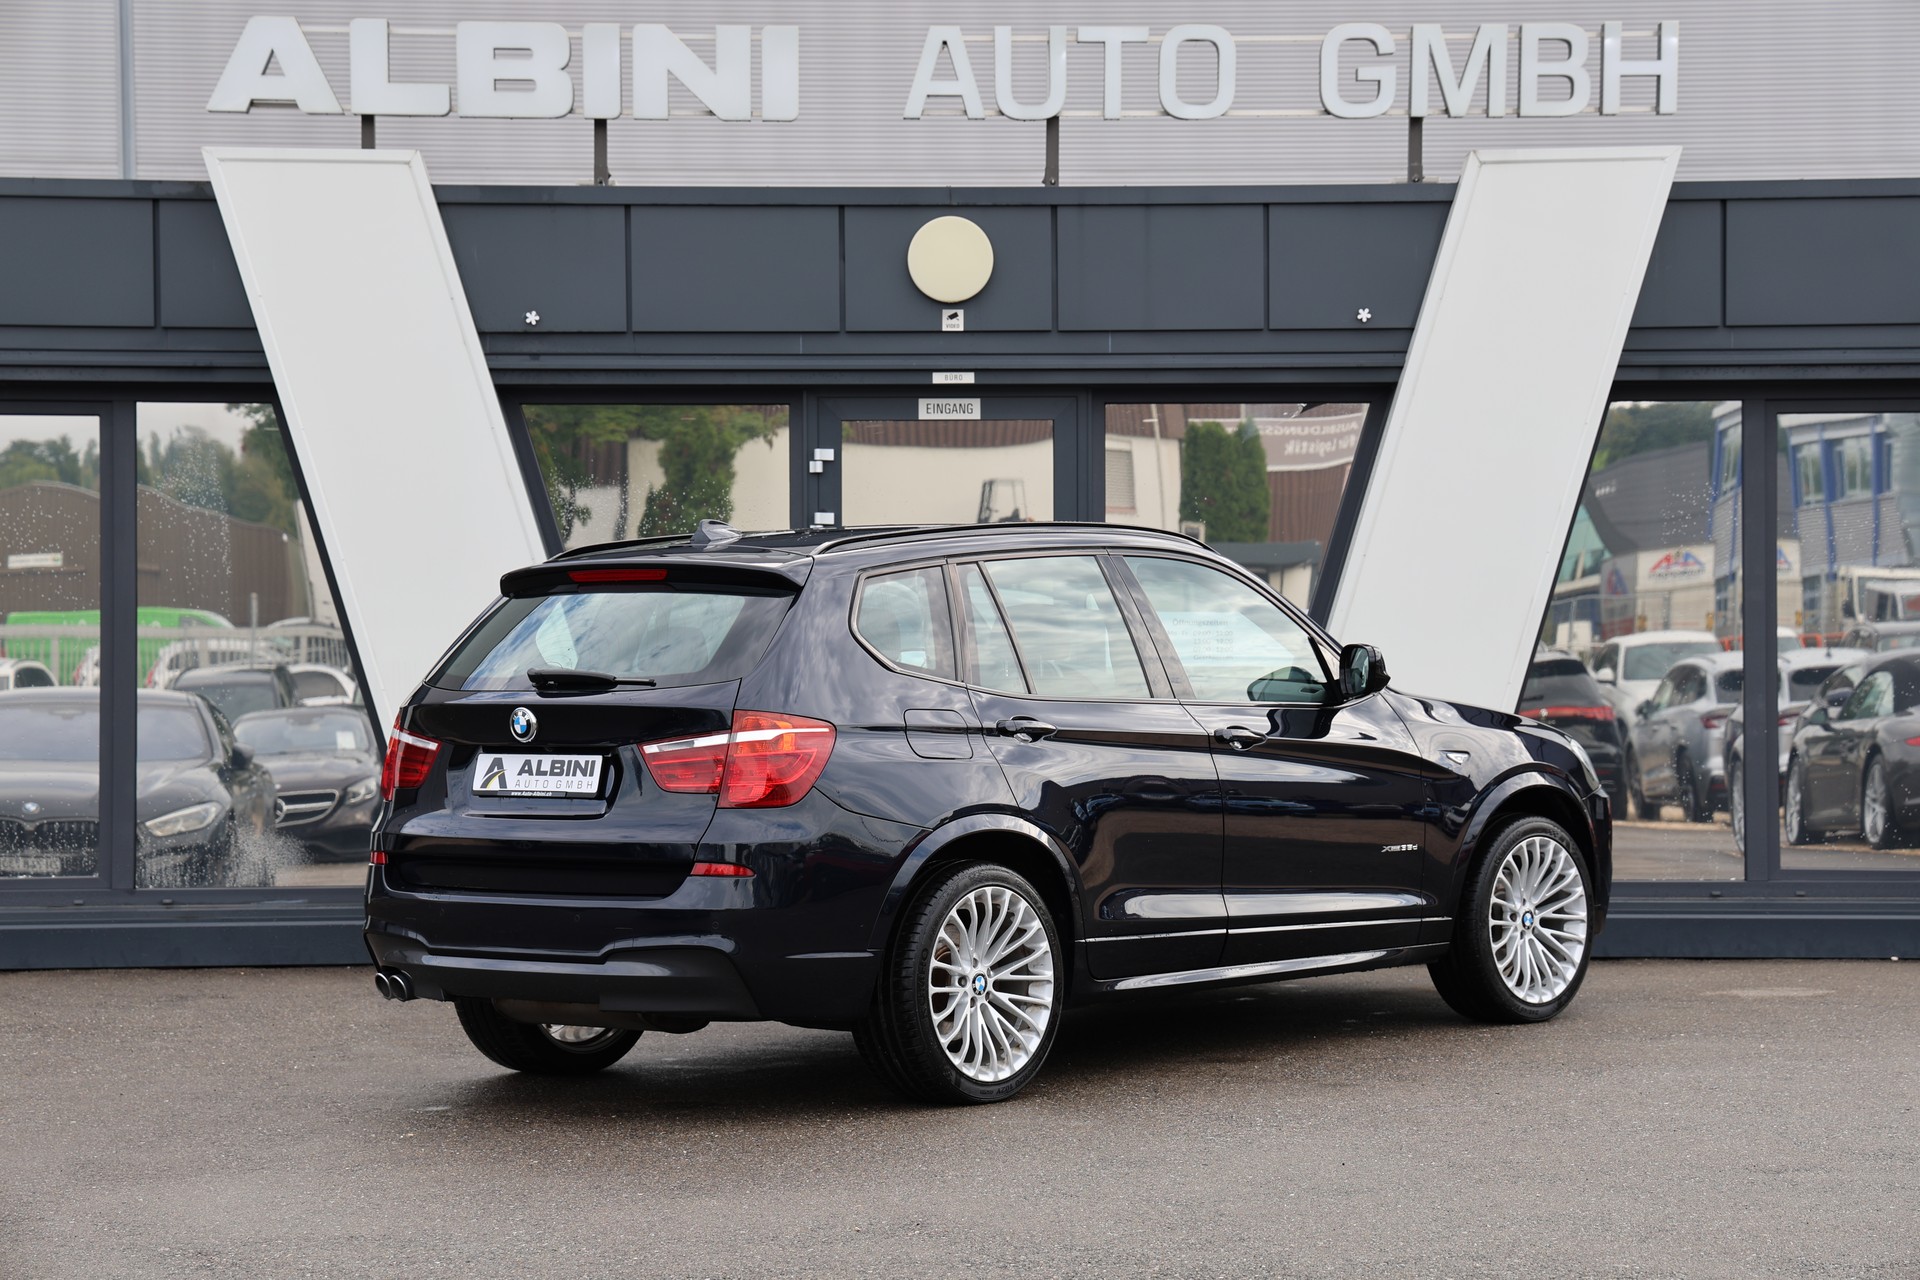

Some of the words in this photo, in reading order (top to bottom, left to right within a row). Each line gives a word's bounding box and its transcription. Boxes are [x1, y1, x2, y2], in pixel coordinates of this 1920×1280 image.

[206, 15, 800, 122] ALBINI
[903, 23, 1237, 121] AUTO
[1318, 20, 1680, 119] GMBH
[926, 403, 974, 414] EINGANG
[517, 758, 597, 777] ALBINI
[515, 780, 549, 789] AUTO
[555, 780, 594, 789] GMBH
